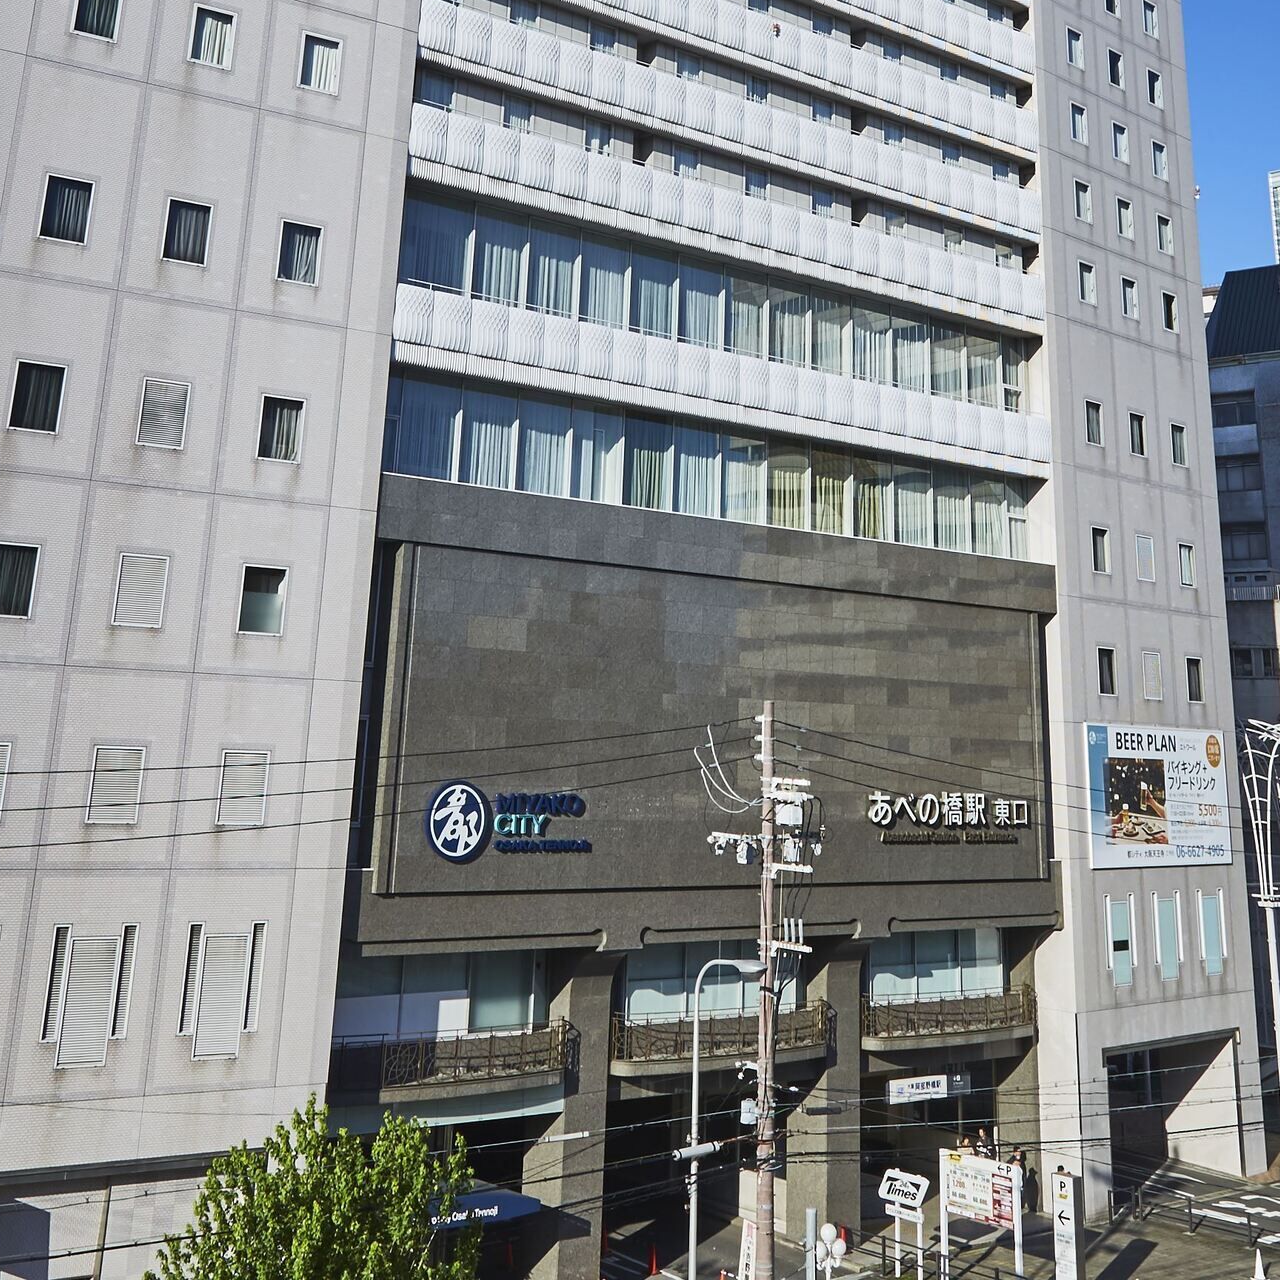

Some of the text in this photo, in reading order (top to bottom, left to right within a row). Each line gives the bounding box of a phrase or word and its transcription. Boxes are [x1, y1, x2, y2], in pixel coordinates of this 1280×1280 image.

[1116, 732, 1144, 751] BEER
[1147, 734, 1177, 752] PLAN
[1168, 777, 1216, 791] フリードリンク
[495, 792, 586, 818] MIYAKO
[868, 790, 1029, 827] あべの橋駅 東口
[494, 813, 548, 836] CITY
[1006, 1165, 1012, 1176] P
[886, 1182, 918, 1201] Times
[1059, 1180, 1066, 1192] P
